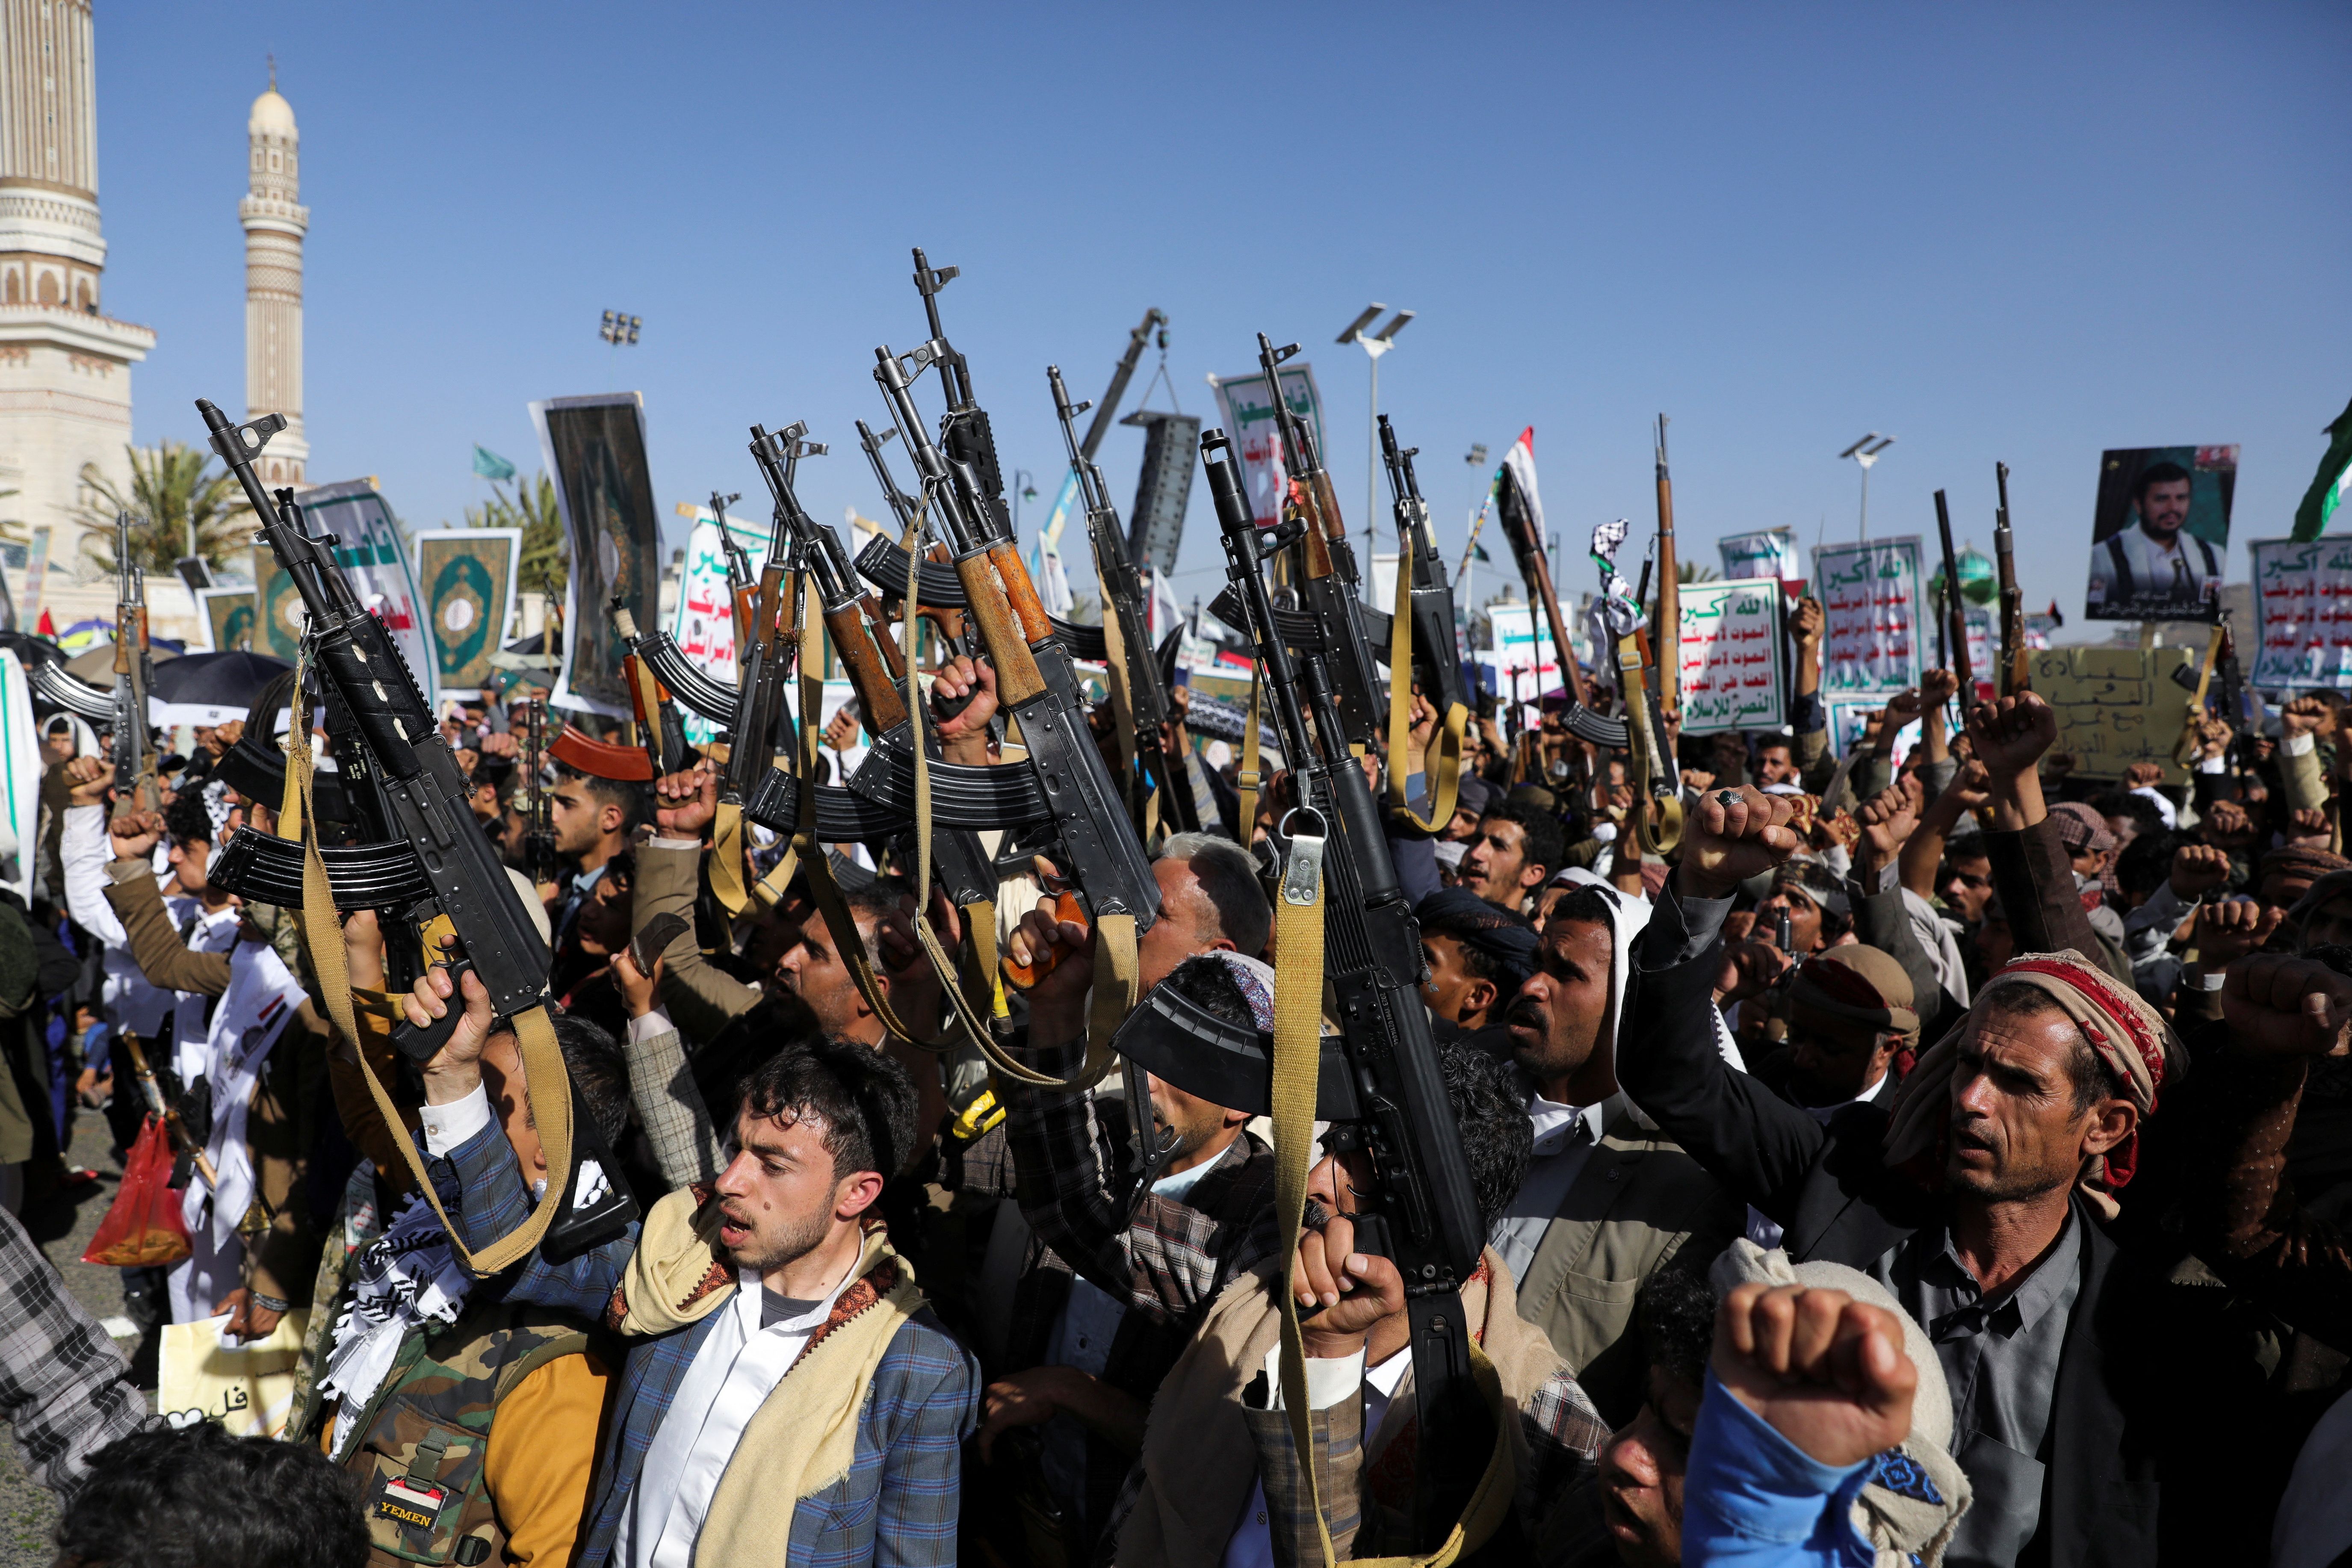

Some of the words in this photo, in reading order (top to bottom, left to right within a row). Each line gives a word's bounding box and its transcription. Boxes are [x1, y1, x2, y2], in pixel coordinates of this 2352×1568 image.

[1682, 592, 1731, 626] أكبر
[1736, 593, 1770, 614] الله
[1380, 992, 1389, 1006] 2023
[381, 1502, 431, 1527] YEMEN
